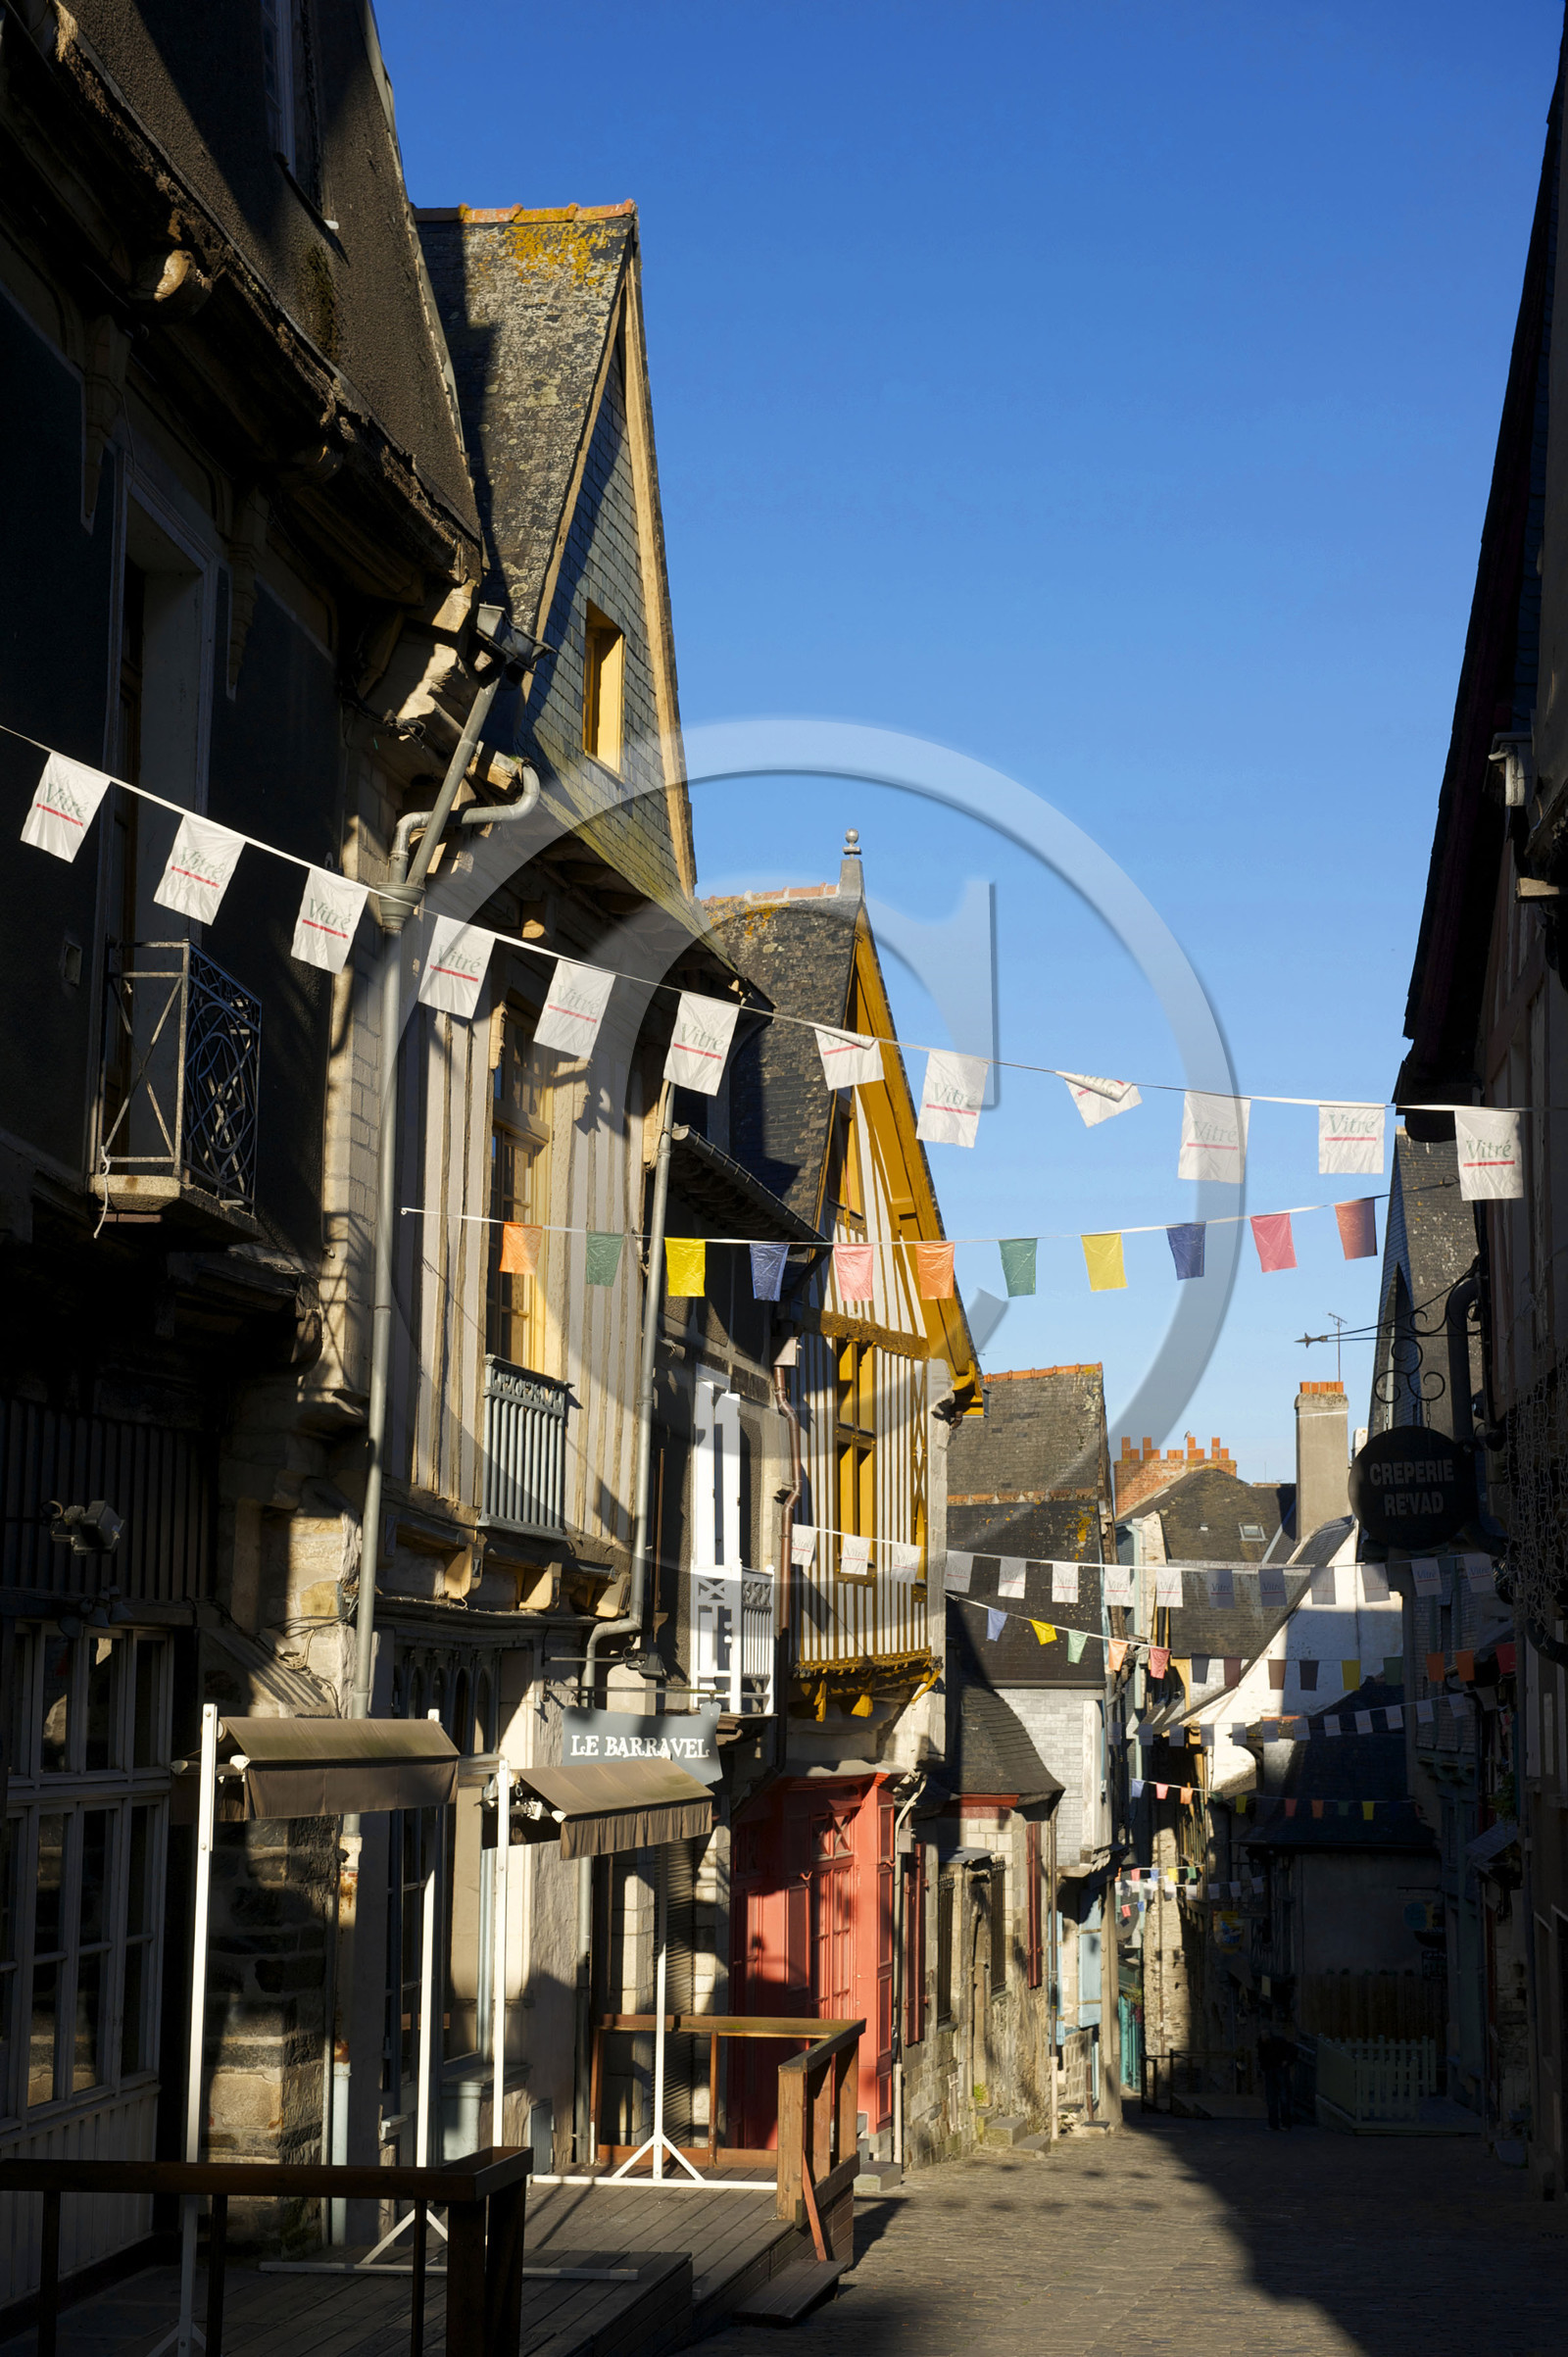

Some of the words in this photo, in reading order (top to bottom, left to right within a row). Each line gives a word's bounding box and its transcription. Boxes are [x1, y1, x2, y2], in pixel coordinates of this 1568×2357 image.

[46, 782, 87, 818] Vitré
[180, 847, 222, 880] Vitré
[309, 898, 351, 930] Vitré
[438, 945, 482, 974] Vitré
[557, 984, 600, 1015] Vitré
[681, 1022, 724, 1052] Vitré
[933, 1082, 978, 1105] Vitré
[1193, 1120, 1239, 1143] Vitré
[1329, 1113, 1376, 1135] Vitré
[1465, 1139, 1511, 1159] Vitré
[570, 1735, 600, 1757] LE
[605, 1736, 710, 1759] BARRAVEL
